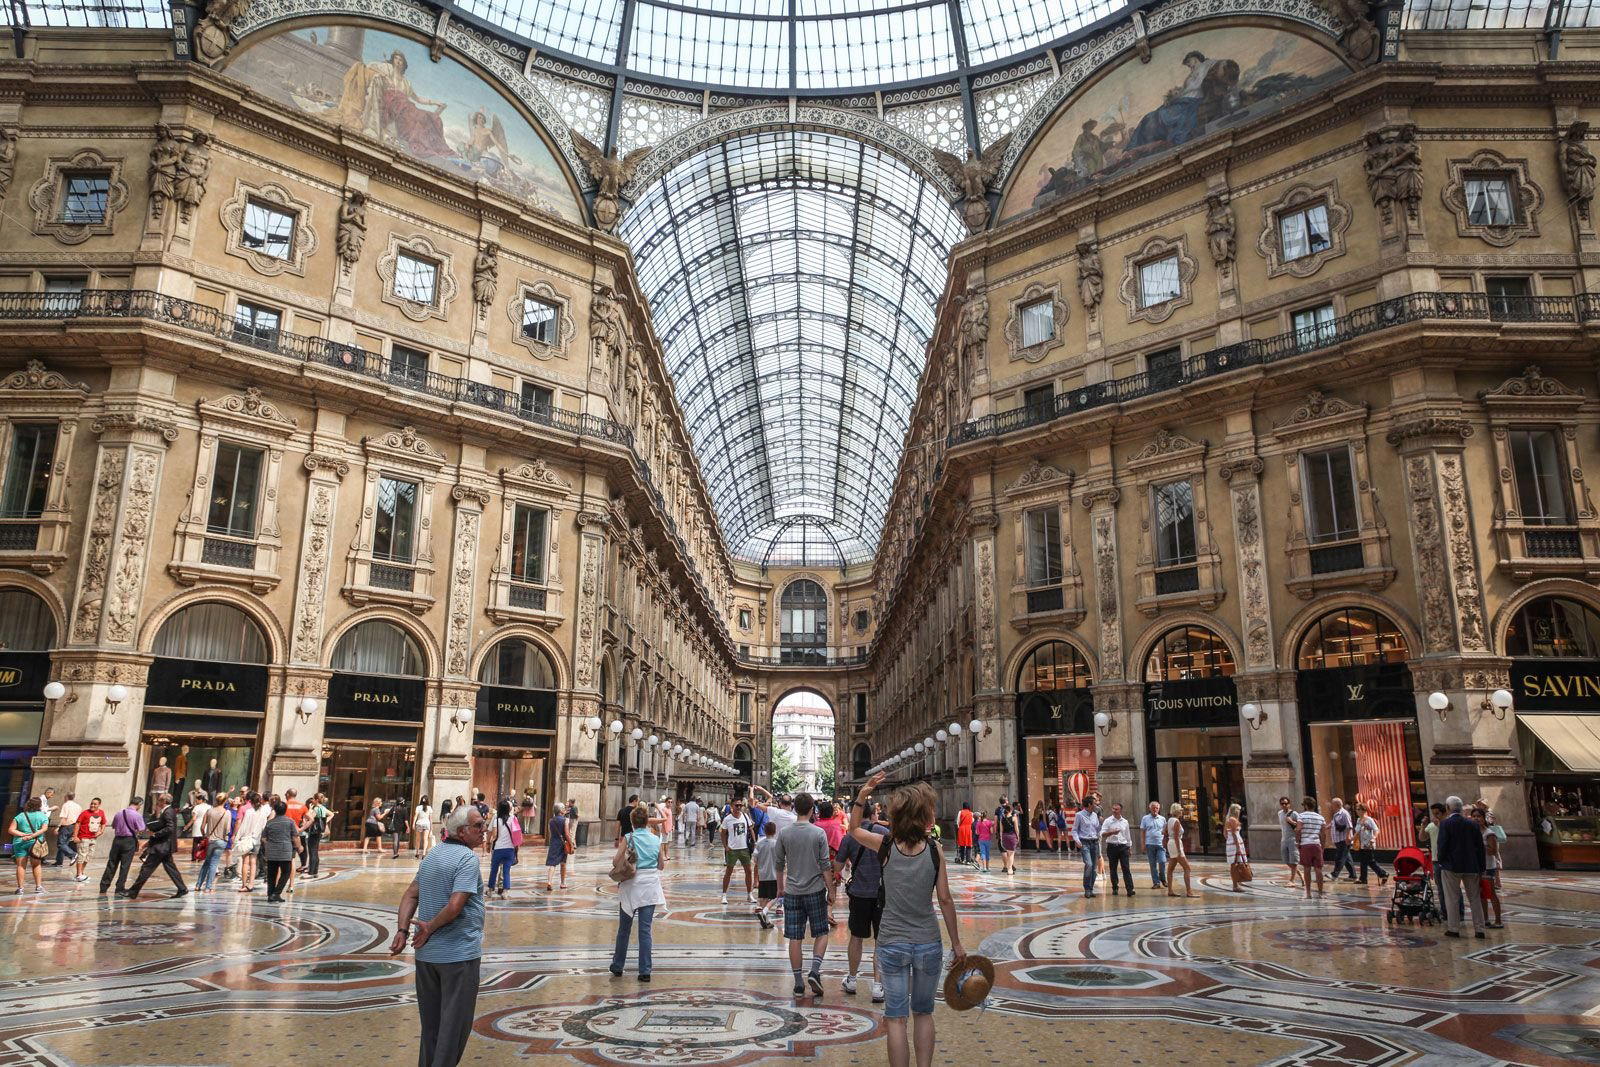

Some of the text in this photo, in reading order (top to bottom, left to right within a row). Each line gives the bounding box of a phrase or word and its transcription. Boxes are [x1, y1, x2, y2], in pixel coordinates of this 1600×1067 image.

[180, 679, 236, 692] PRADA
[354, 692, 399, 704] PRADA
[1153, 695, 1233, 710] LOUIS VUITTON
[497, 703, 535, 714] PRADA
